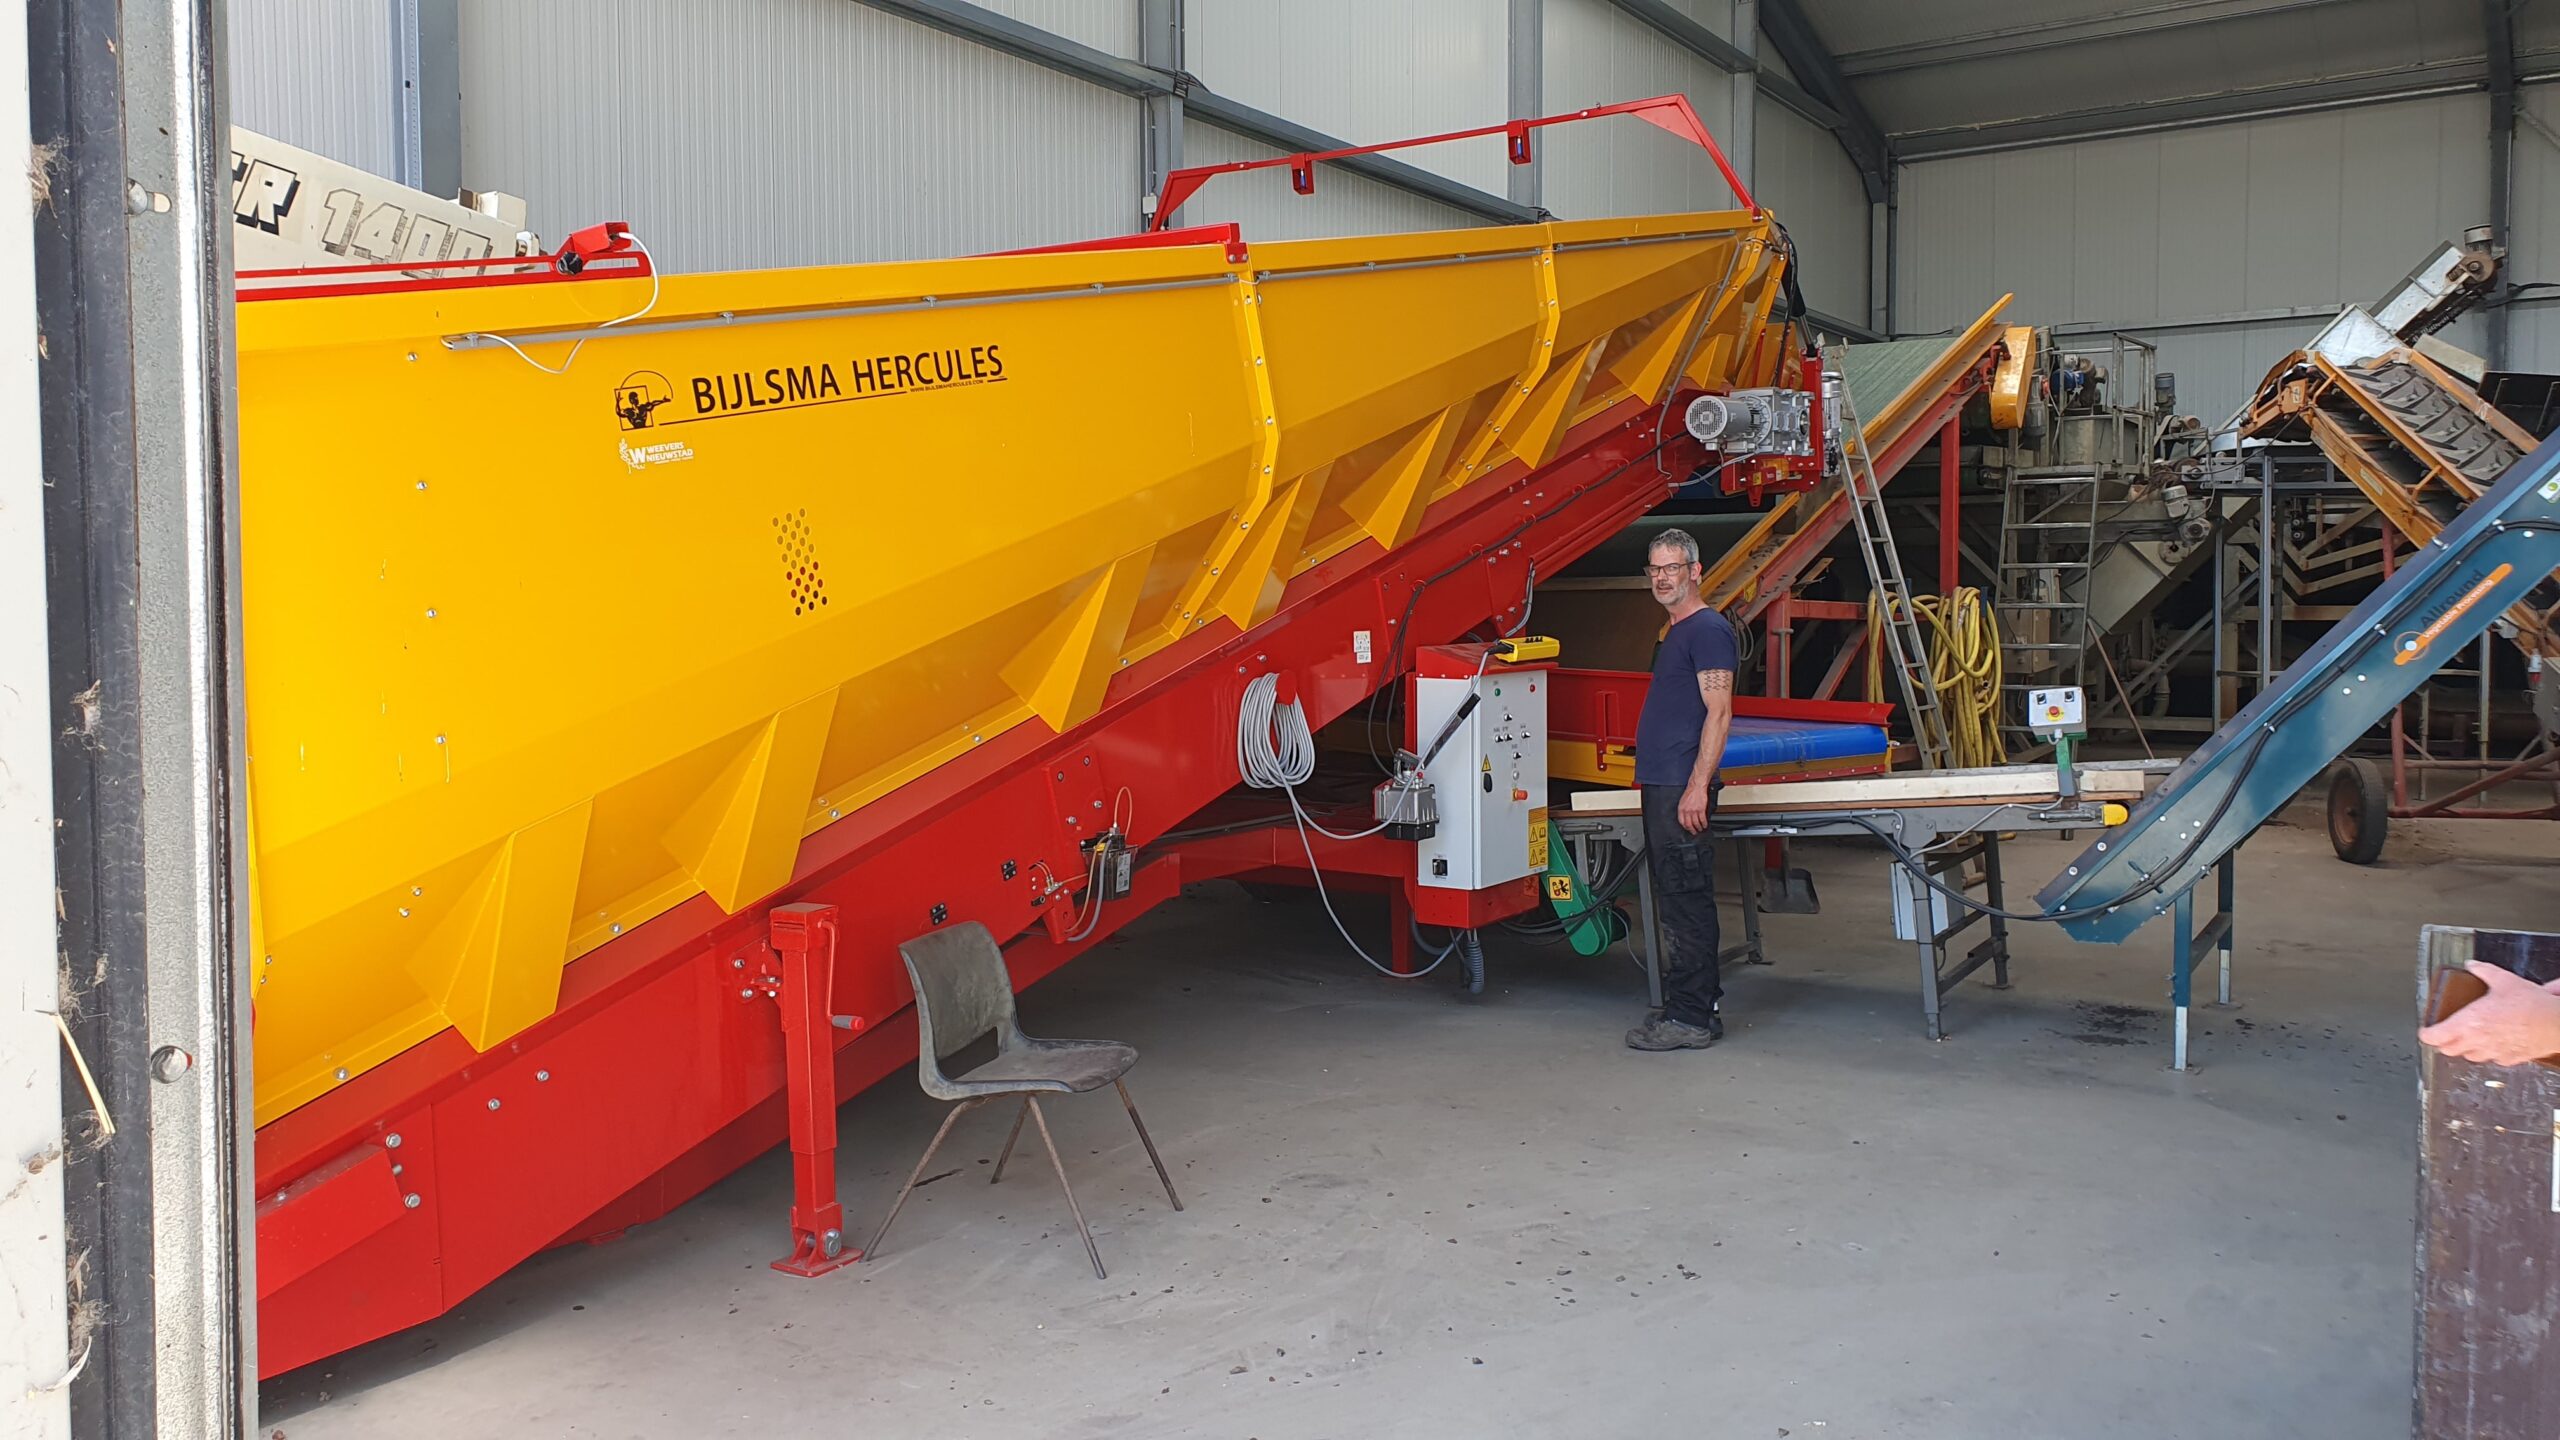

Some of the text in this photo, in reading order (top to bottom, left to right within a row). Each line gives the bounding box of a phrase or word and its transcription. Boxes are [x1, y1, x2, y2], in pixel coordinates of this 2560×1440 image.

[691, 344, 1003, 414] BIJLSMA HERCULES
[646, 441, 685, 454] WEEVERS
[646, 448, 694, 463] NIEUWSTAD
[2421, 569, 2487, 628] Allround
[2423, 579, 2495, 638] Vegetable Processing
